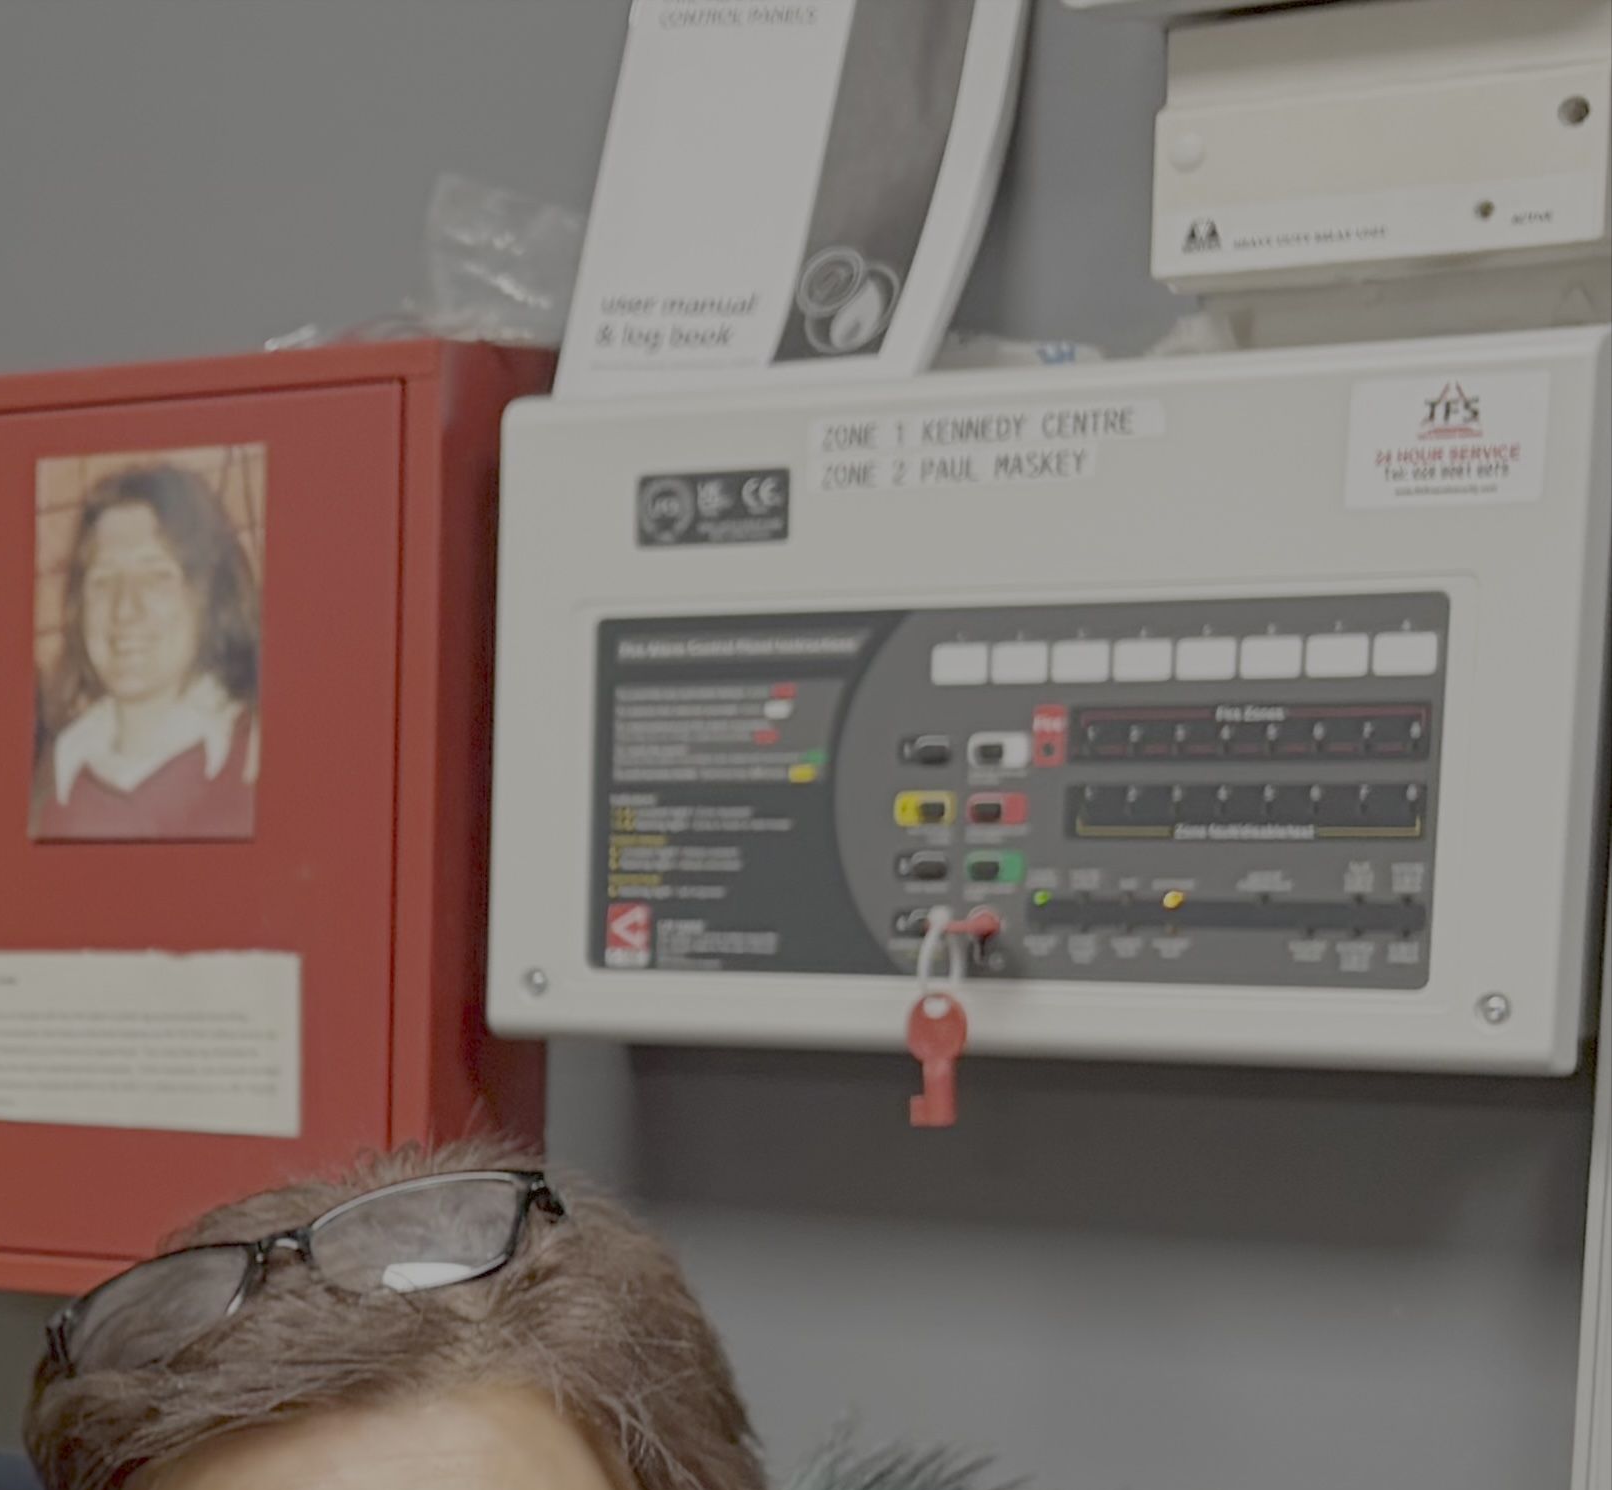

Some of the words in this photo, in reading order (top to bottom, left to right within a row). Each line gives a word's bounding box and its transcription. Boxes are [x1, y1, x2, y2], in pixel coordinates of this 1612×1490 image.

[659, 7, 742, 31] CONTROL
[600, 296, 655, 316] user
[661, 290, 758, 316] manual
[595, 323, 614, 347] &
[623, 323, 662, 354] log
[668, 322, 734, 347] book
[822, 421, 877, 452] ZONE
[894, 419, 906, 447] 1
[921, 412, 1028, 446] KENNEDY
[1040, 405, 1136, 440] CENTRE
[1396, 446, 1444, 465] HOUR
[1449, 441, 1521, 463] SERVICE
[822, 461, 877, 492] ZONE
[890, 458, 907, 488] 2
[920, 454, 980, 485] PAUL
[992, 448, 1086, 481] MASKEY
